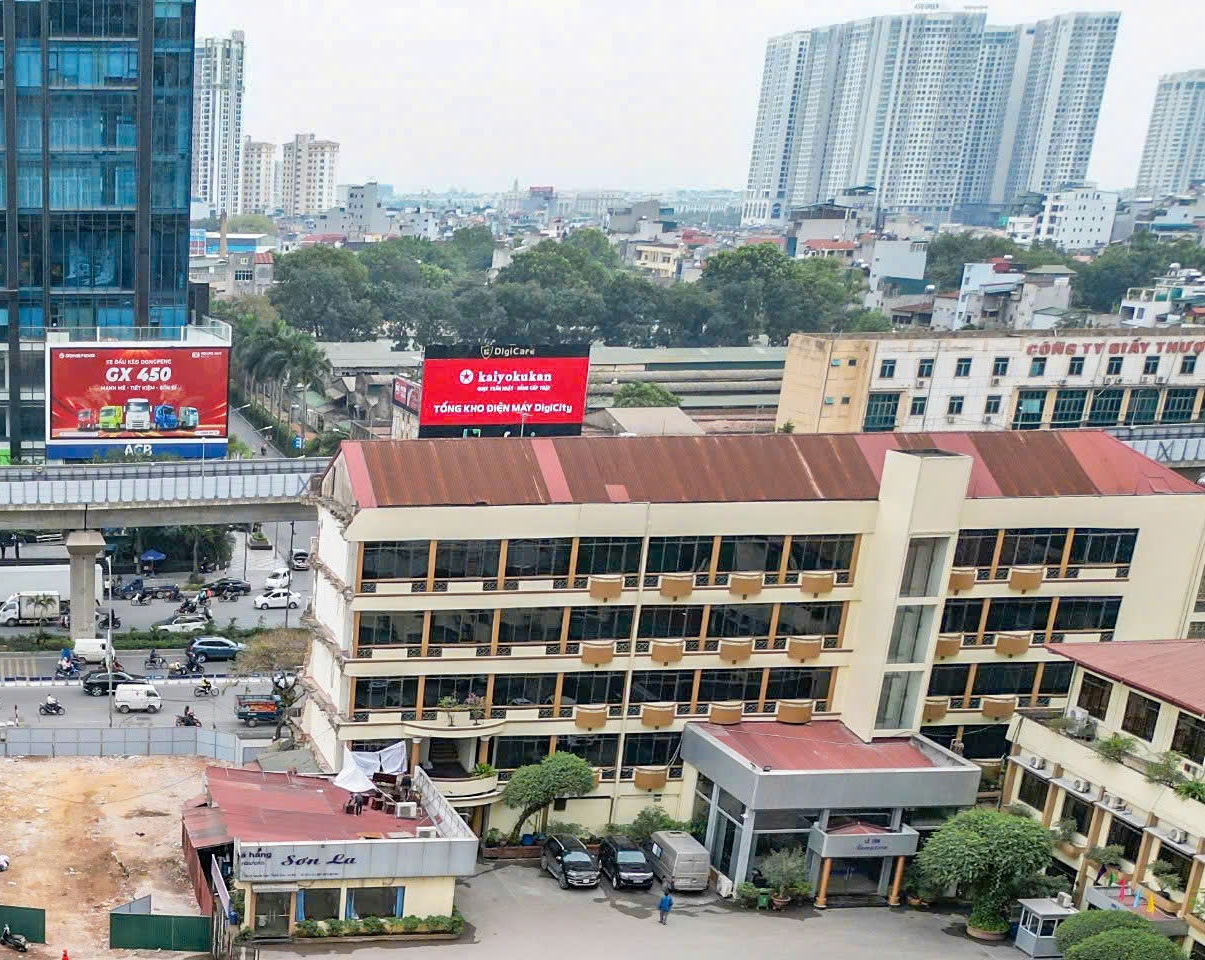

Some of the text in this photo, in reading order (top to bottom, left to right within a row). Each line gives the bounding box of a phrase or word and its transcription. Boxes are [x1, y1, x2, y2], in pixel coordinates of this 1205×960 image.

[1027, 341, 1077, 356] CÔNG
[1083, 343, 1105, 354] TY
[106, 367, 172, 382] GX 450
[478, 369, 552, 384] kaiyokukan
[434, 401, 572, 414] TỔNG KHO ĐIỆN MÁY DigiCity
[124, 444, 152, 456] ACB
[281, 853, 320, 866] Sơn
